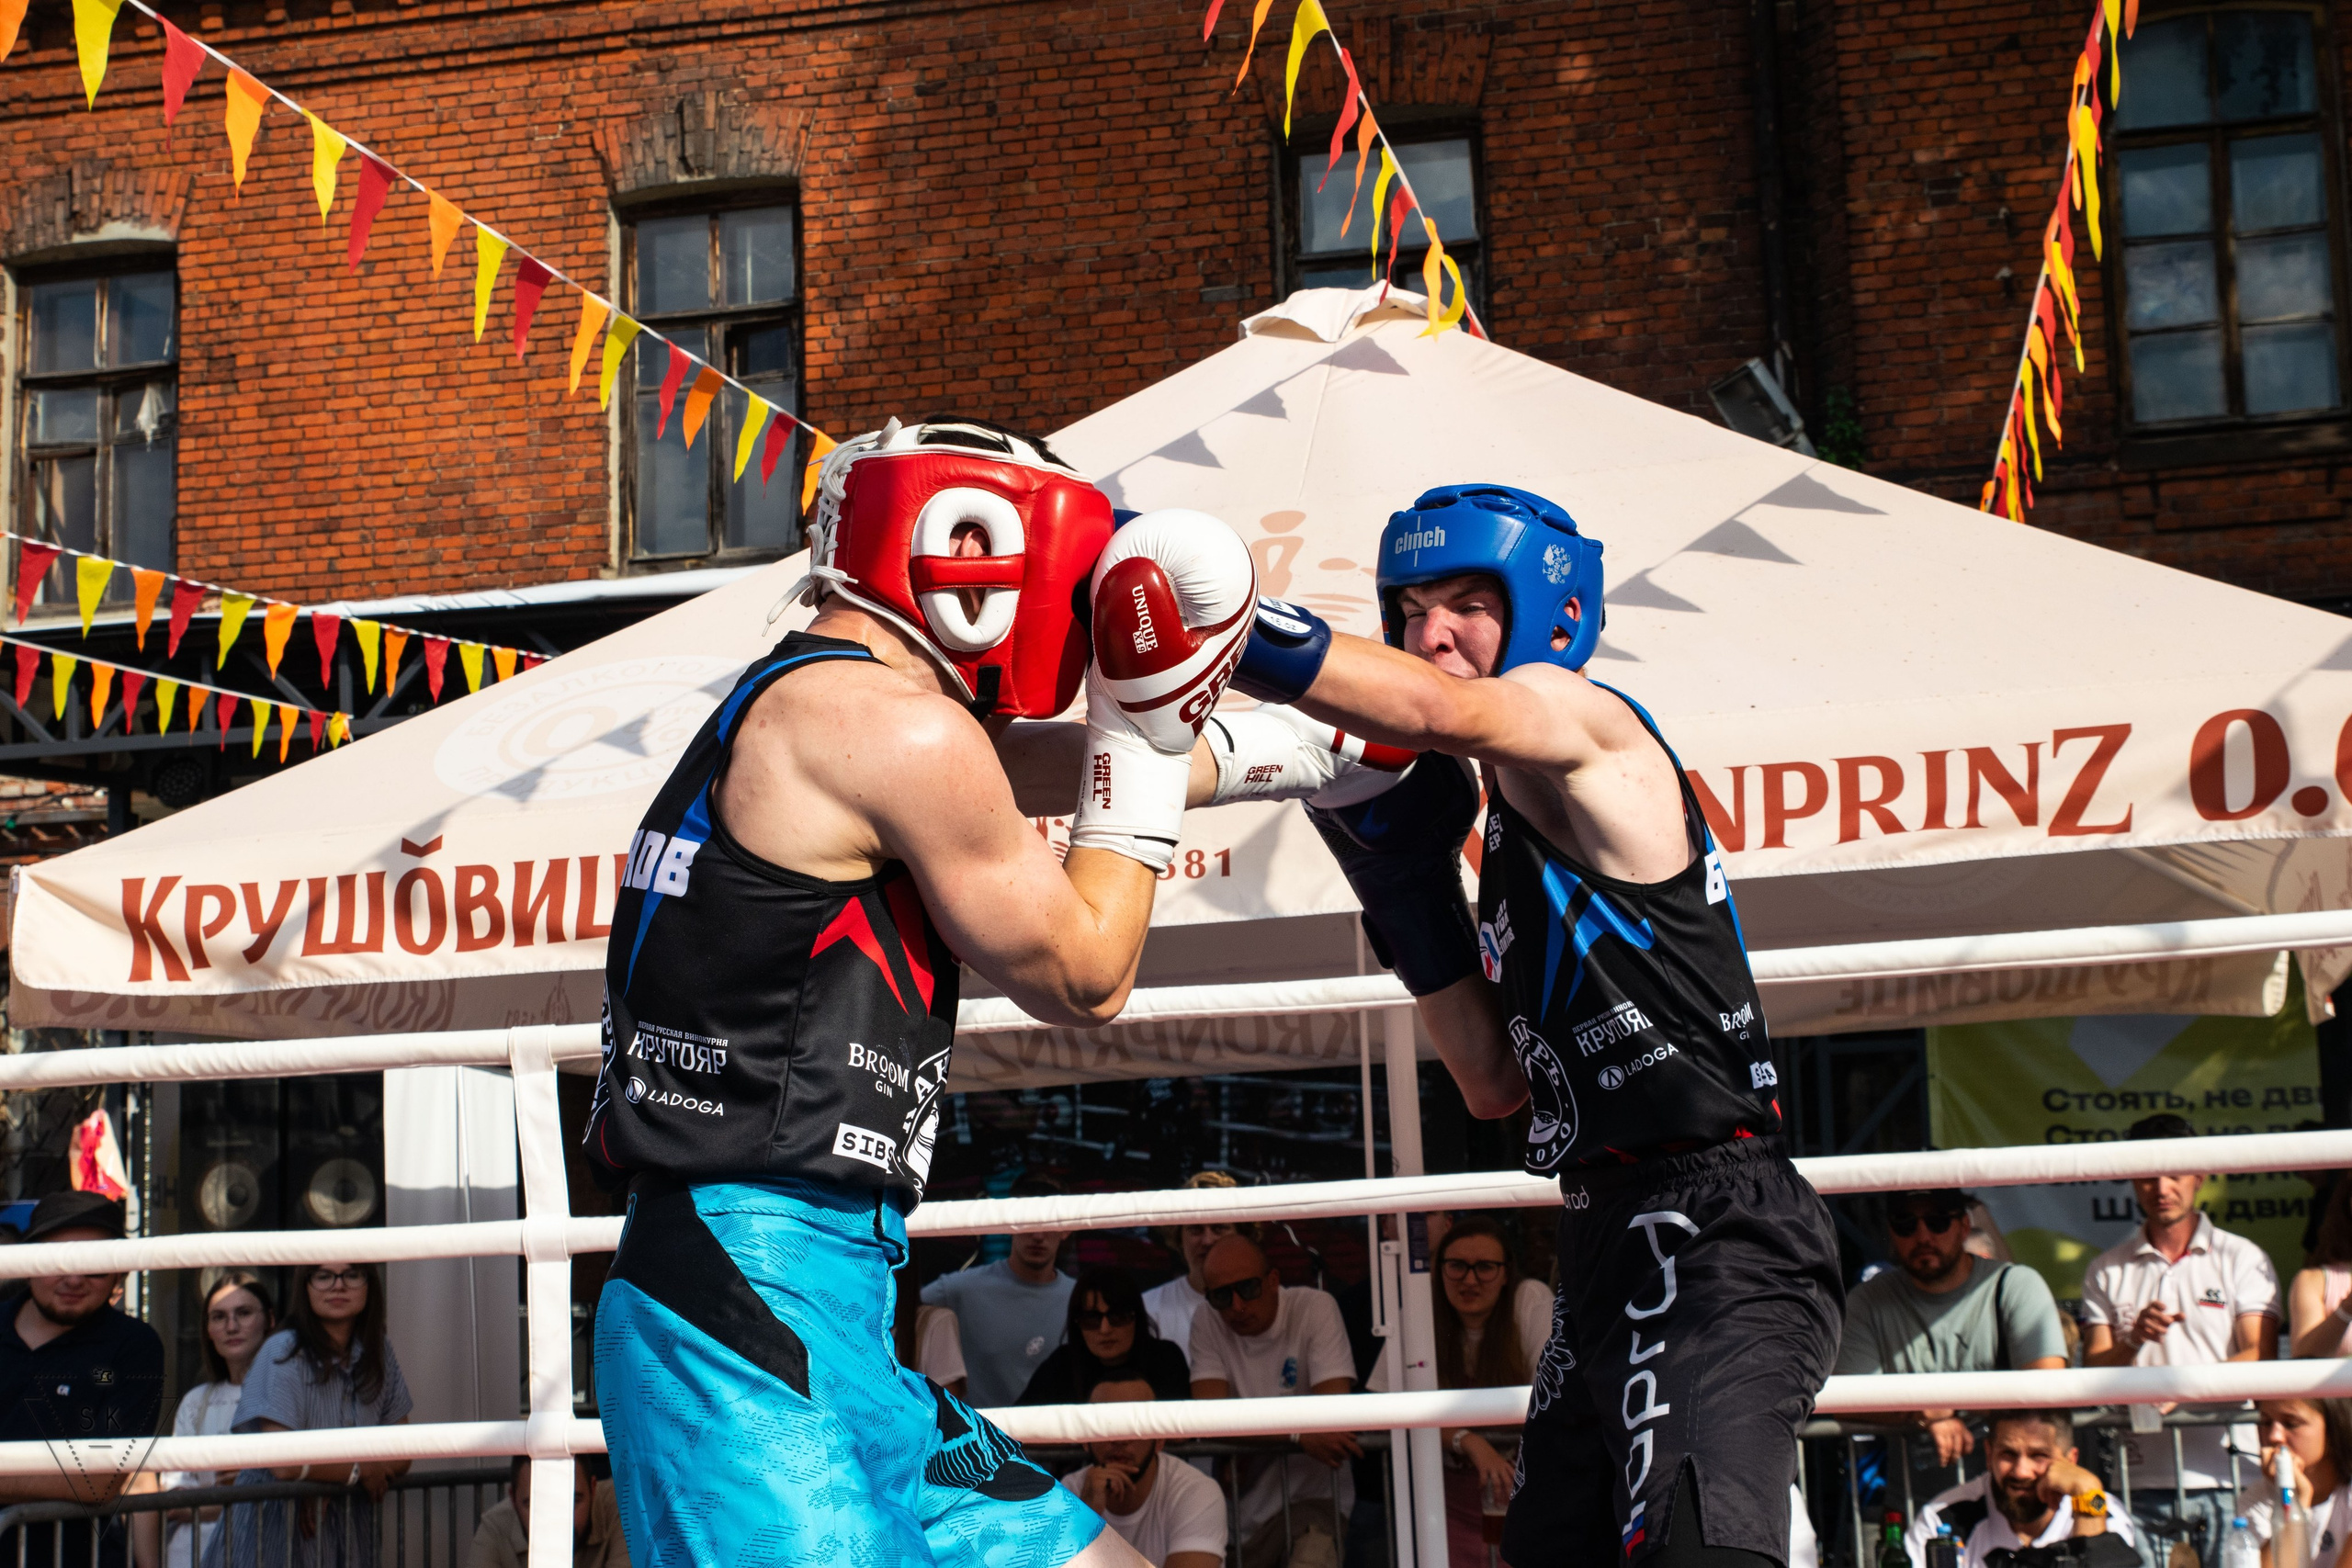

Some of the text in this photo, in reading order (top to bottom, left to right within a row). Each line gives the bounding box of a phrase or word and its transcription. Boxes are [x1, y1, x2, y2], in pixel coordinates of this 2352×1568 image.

[1394, 525, 1446, 555] clinch
[1131, 583, 1159, 651] UNIQUE
[1178, 630, 1250, 725] GRE
[1093, 755, 1102, 802] HILL
[1102, 751, 1112, 809] GREEN
[1243, 773, 1273, 784] HILL
[1247, 764, 1284, 775] GREEN
[1688, 708, 2352, 853] NPRINZ 0.
[627, 1030, 728, 1076] КРУТОЯР
[655, 1026, 683, 1039] РУССКАЯ
[684, 1032, 729, 1047] ВИНОКУРНЯ
[848, 1043, 910, 1092] BROOM
[1624, 1043, 1679, 1077] LADOGA
[648, 1089, 725, 1117] LADOGA
[876, 1080, 893, 1099] GIN
[2042, 1087, 2196, 1112] Стоять,
[2204, 1088, 2251, 1108] не
